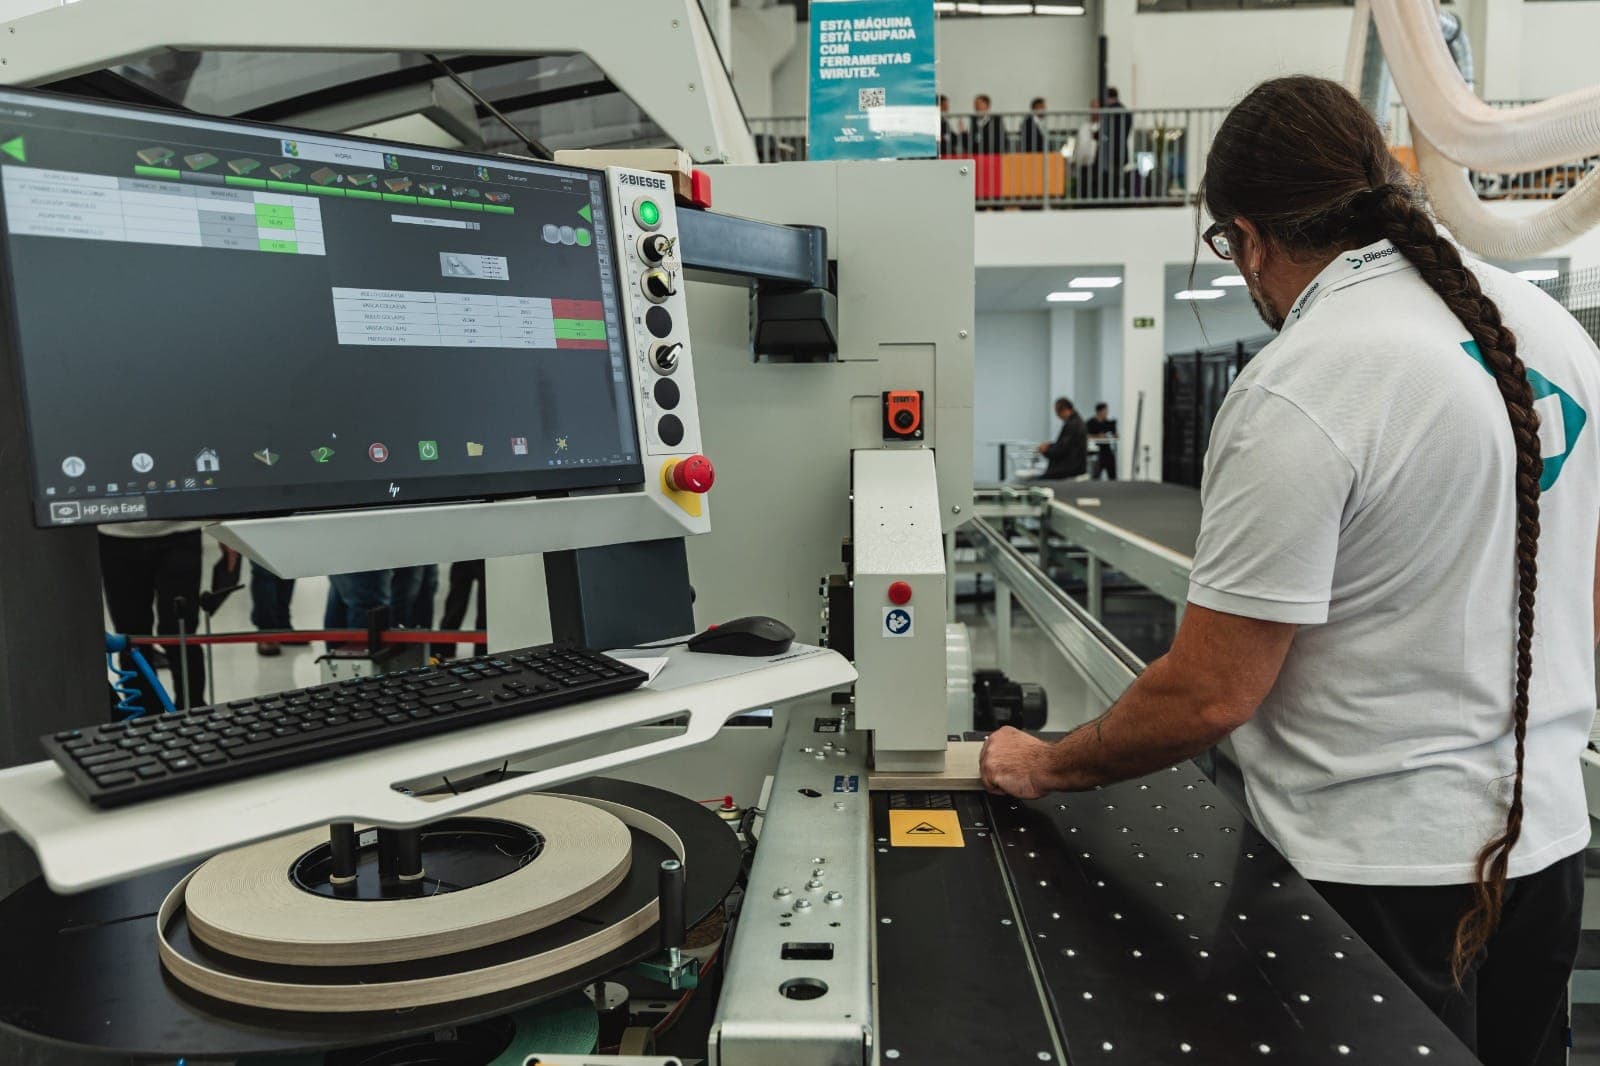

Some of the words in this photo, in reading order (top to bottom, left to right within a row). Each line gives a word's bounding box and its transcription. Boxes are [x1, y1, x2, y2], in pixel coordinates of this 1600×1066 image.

[820, 20, 852, 31] ESTA
[854, 17, 912, 29] MÁQUINA
[854, 29, 916, 41] EQUIPADA
[820, 44, 849, 55] COM
[820, 53, 911, 67] FERRAMENTAS
[820, 67, 880, 79] WIRUTEX.
[629, 174, 667, 190] BIESSE
[1363, 245, 1399, 263] Biesse
[318, 447, 329, 463] 2
[389, 482, 400, 498] hp
[83, 504, 98, 515] HP
[101, 504, 119, 517] Eye
[121, 503, 145, 513] Ease
